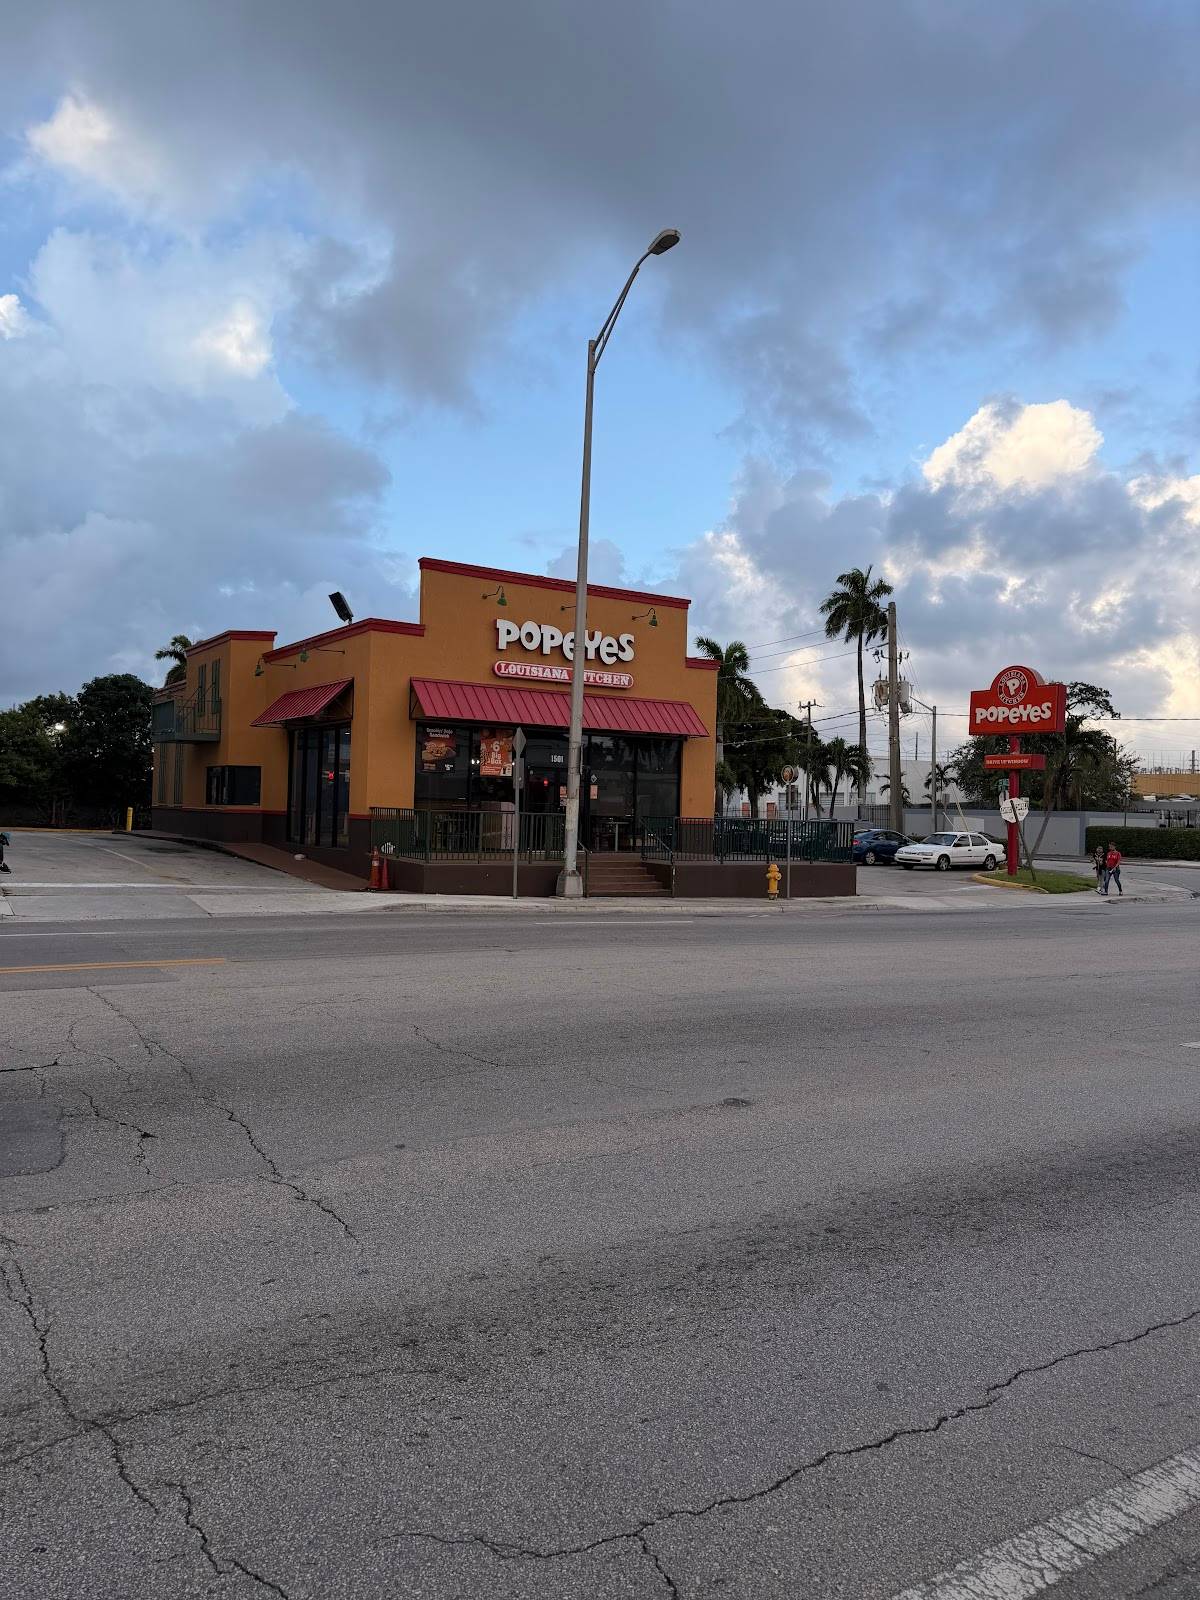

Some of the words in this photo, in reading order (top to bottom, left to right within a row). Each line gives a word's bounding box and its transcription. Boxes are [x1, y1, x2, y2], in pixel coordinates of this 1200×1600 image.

[500, 663, 569, 680] LOUISIANA
[583, 671, 630, 686] ITCHEN
[1006, 678, 1020, 695] P
